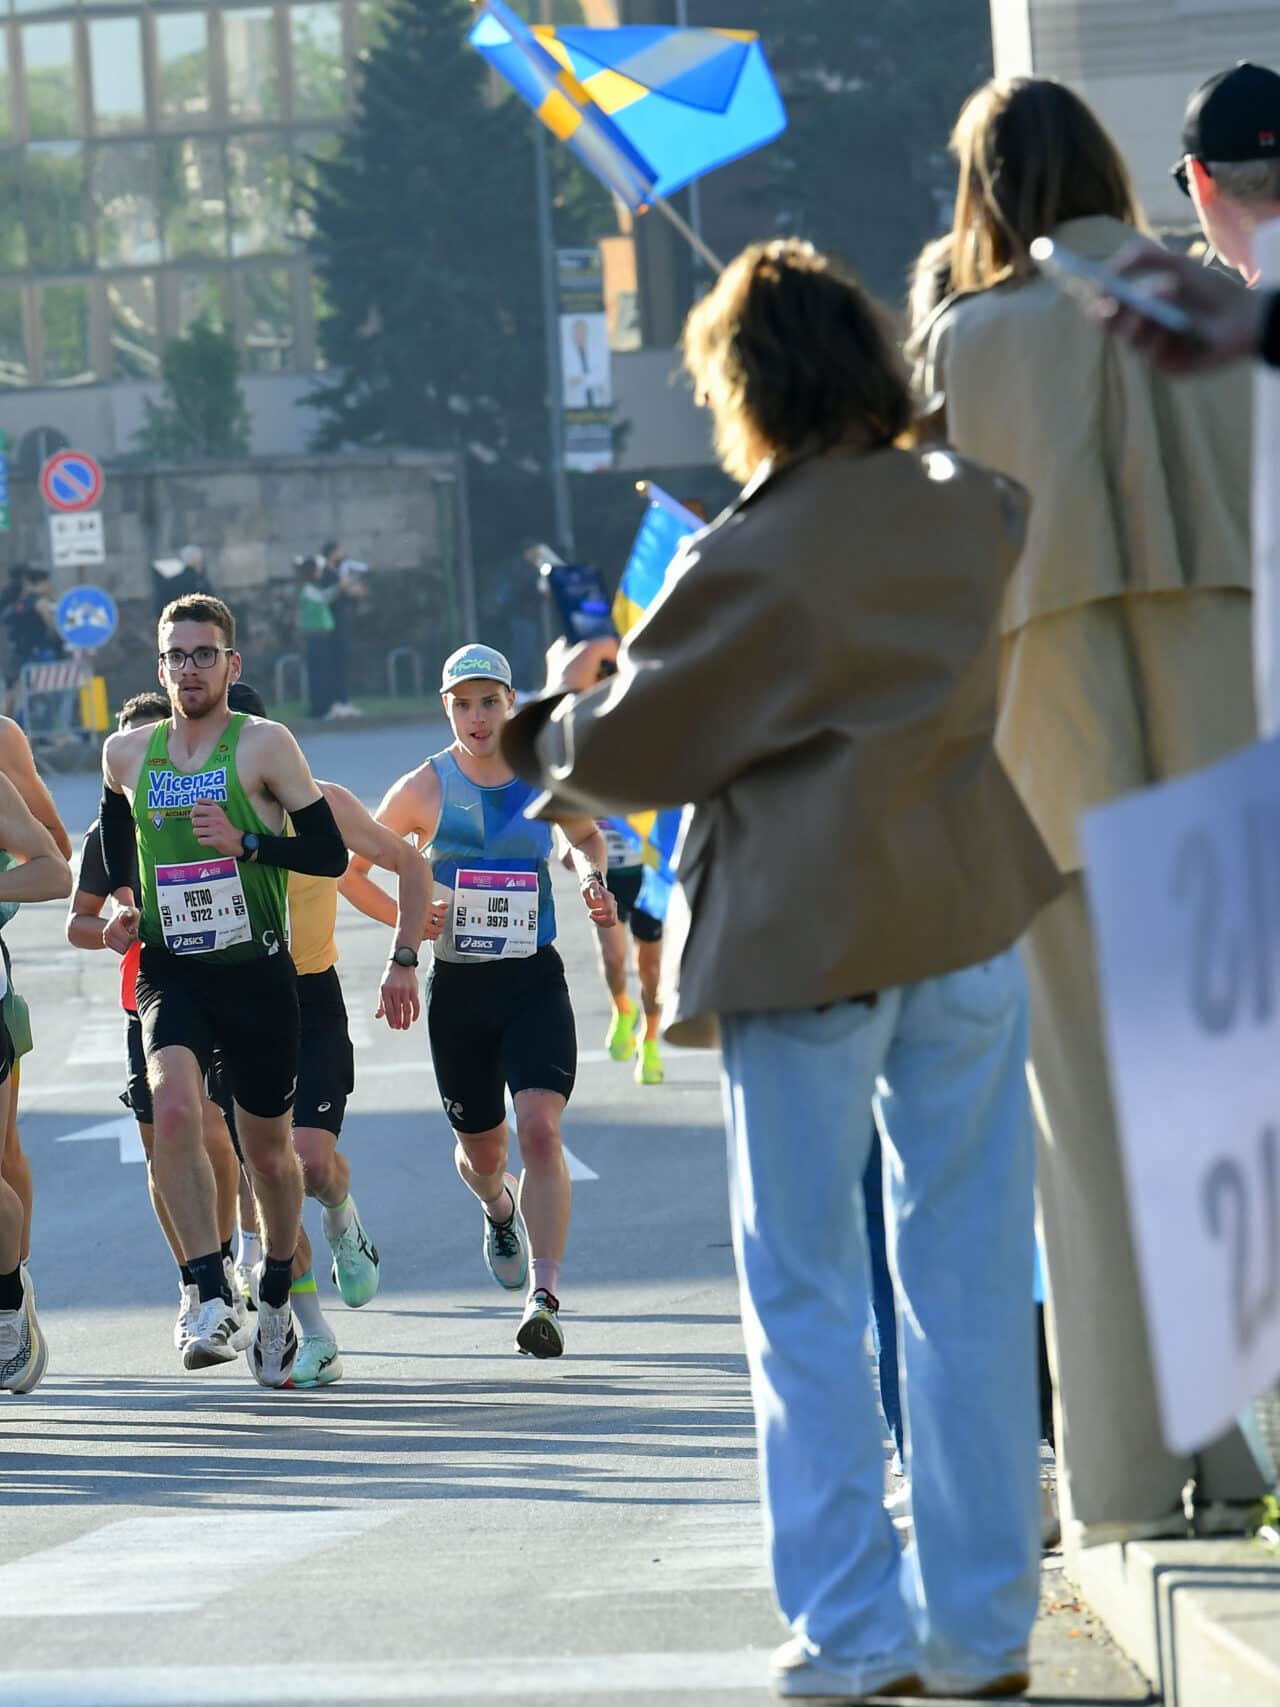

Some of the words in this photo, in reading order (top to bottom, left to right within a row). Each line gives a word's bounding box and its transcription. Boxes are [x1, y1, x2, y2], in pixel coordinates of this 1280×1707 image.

[149, 768, 226, 791] Vicenza
[148, 788, 227, 807] Marathon
[184, 888, 213, 908] PIETRO
[488, 897, 509, 913] LUCA
[190, 908, 213, 922] 9722
[486, 915, 508, 928] 3979
[183, 936, 204, 946] asics
[471, 940, 493, 949] asics
